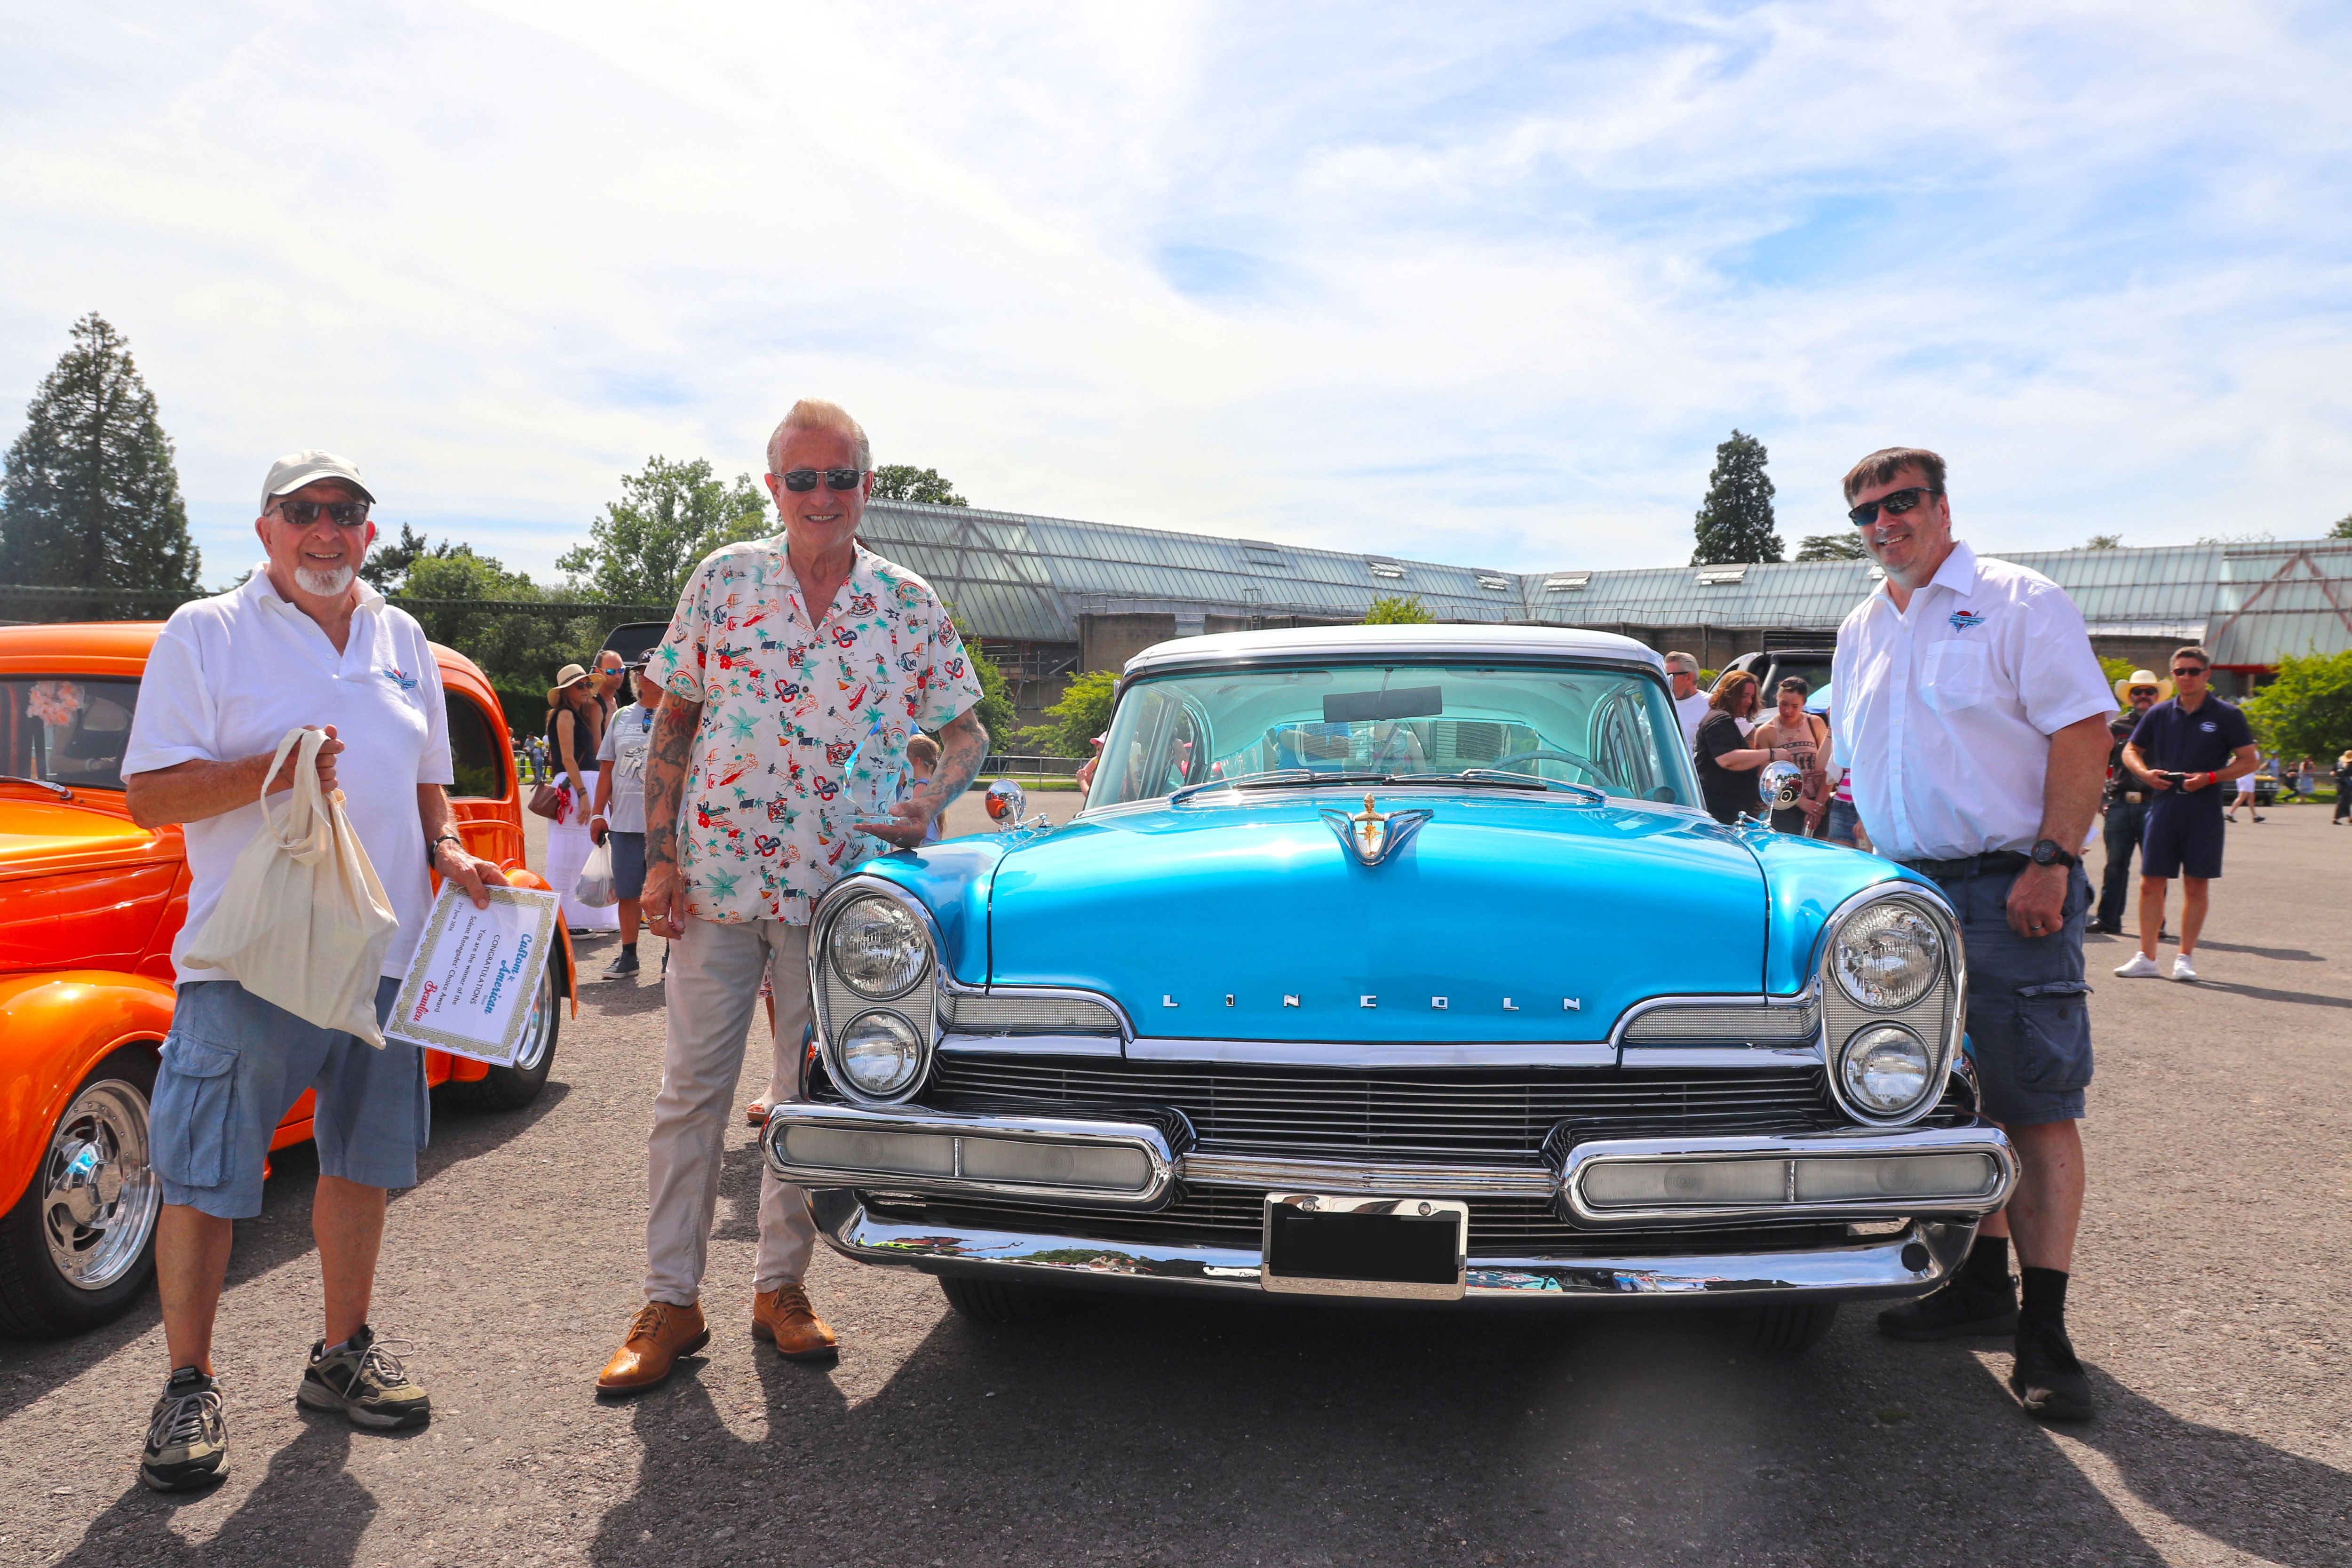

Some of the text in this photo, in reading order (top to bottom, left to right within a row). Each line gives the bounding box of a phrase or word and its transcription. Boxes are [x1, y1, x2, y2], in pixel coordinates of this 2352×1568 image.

[477, 930, 486, 940] You
[511, 934, 532, 974] Custom
[434, 915, 477, 1012] Solent Renegades' Choice Award
[460, 965, 471, 986] winner
[470, 935, 500, 1004] CONGRATULATIONS
[413, 980, 437, 1022] Beaulieu
[485, 960, 510, 1013] American
[1162, 994, 1581, 1011] LINCOLN
